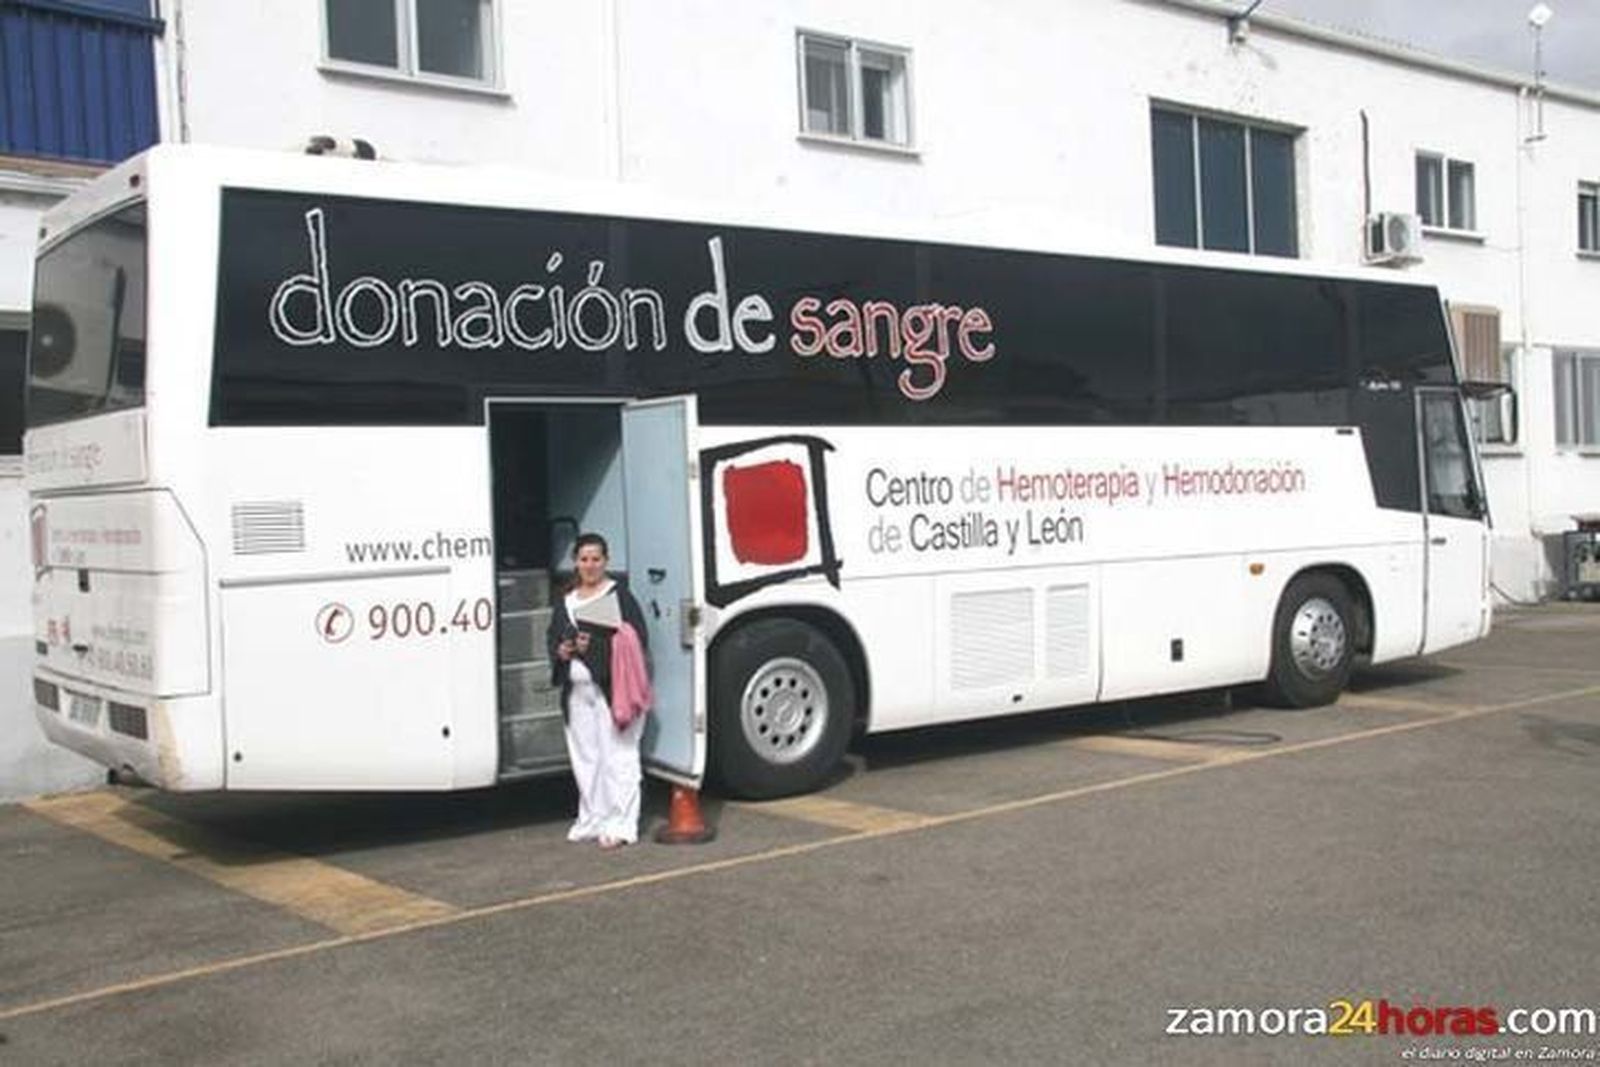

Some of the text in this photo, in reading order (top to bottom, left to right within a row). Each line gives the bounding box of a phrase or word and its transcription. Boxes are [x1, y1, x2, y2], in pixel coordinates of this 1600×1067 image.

[269, 208, 995, 400] donación de sangre
[866, 460, 1306, 508] Centro de Hemoterapia y Hemodonación
[868, 506, 1083, 555] de Castilla y León
[368, 597, 492, 641] 900.40
